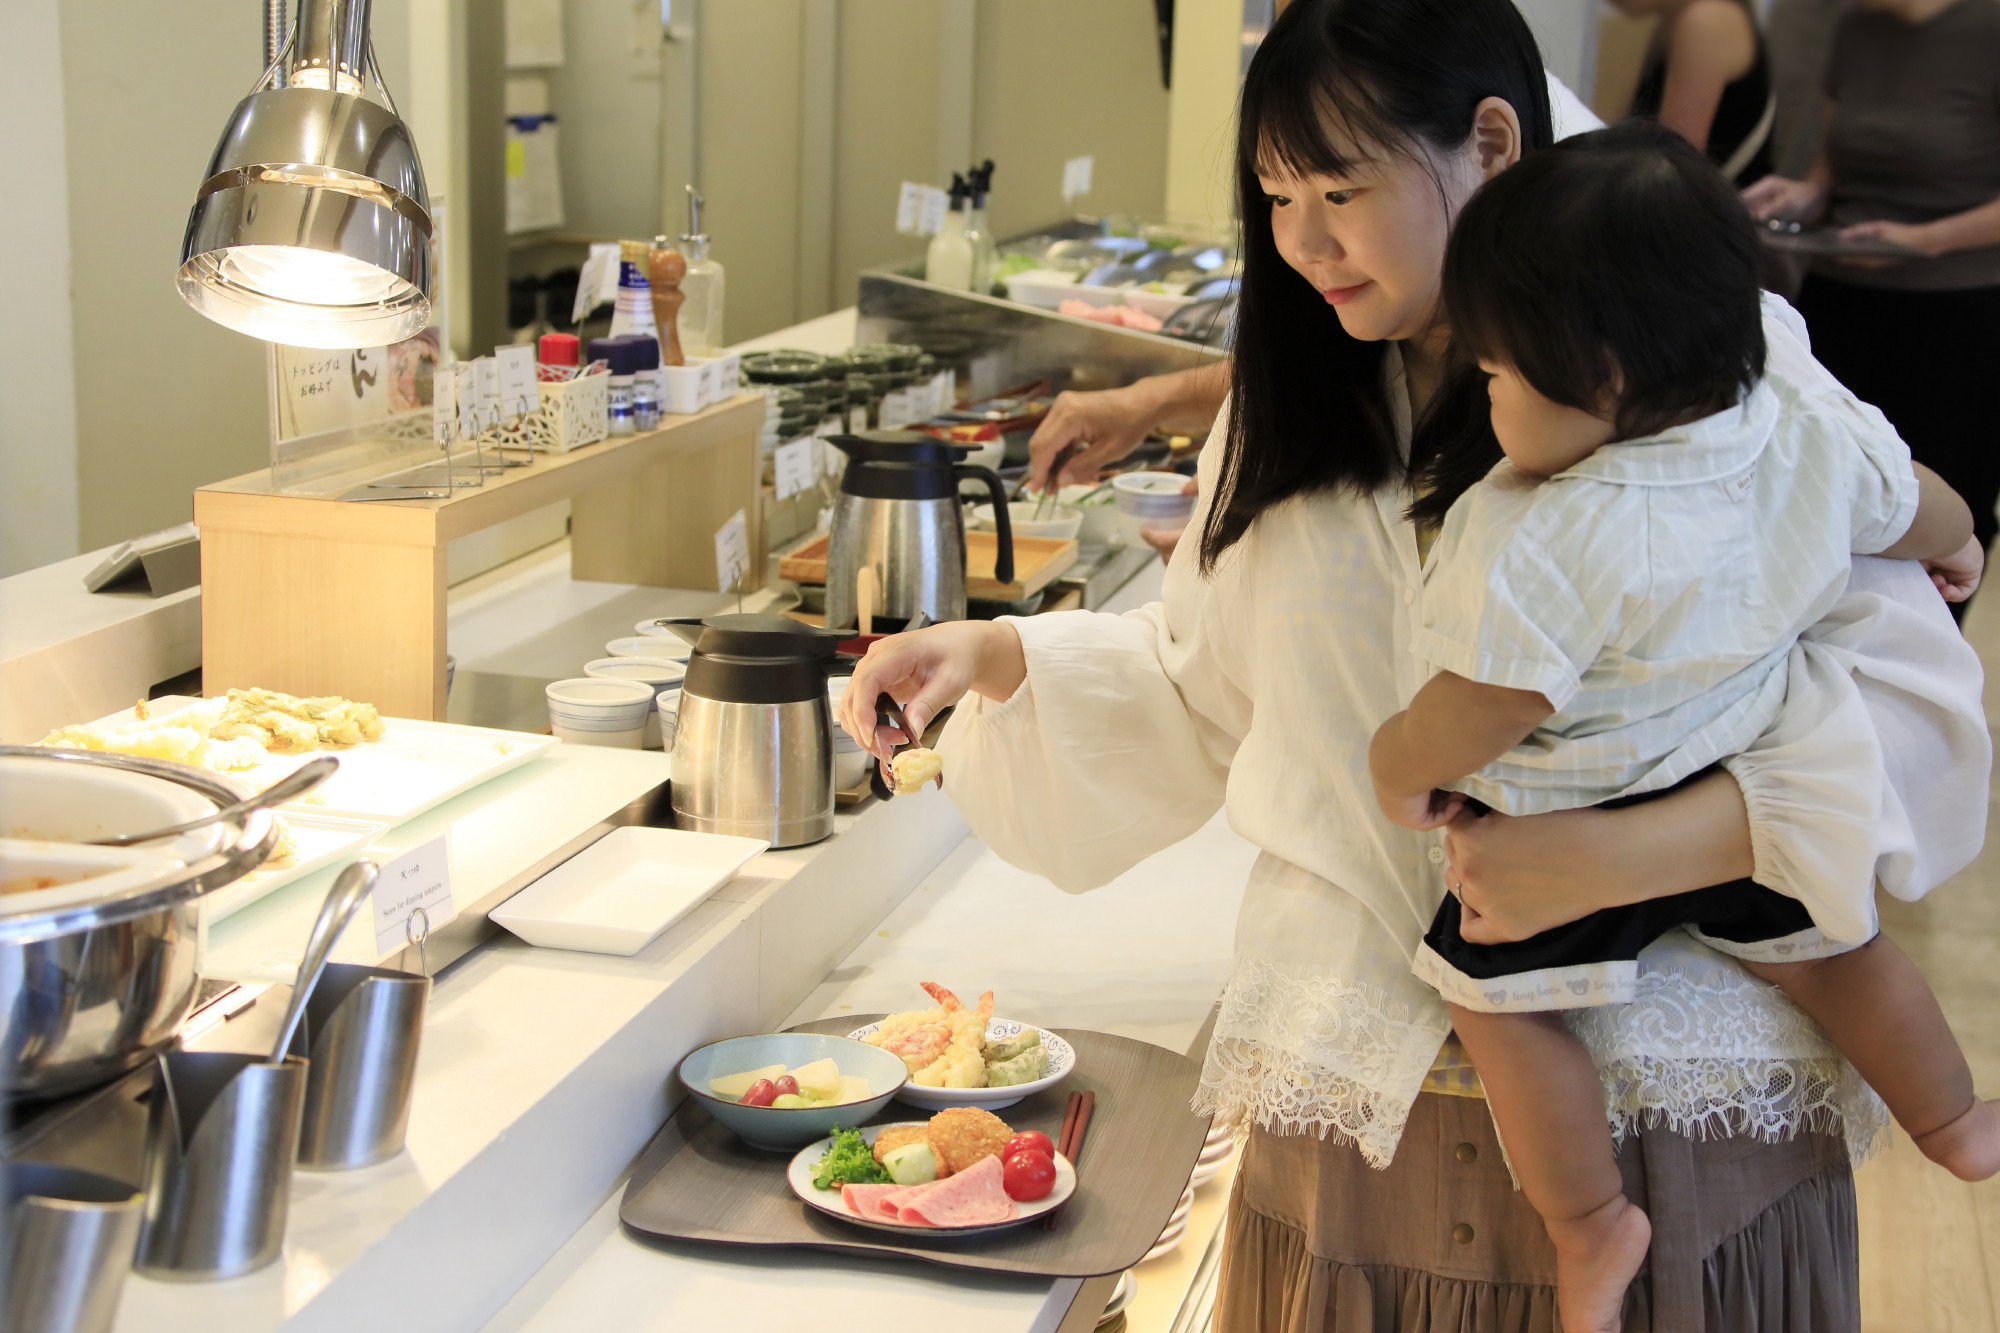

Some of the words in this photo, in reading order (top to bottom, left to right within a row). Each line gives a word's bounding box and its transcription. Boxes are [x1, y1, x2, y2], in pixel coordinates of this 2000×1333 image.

[293, 358, 340, 378] トッピングは
[400, 864, 420, 880] 天つゆ
[1512, 990, 1535, 1002] tiny
[1536, 982, 1562, 996] bear
[1594, 981, 1615, 993] tiny
